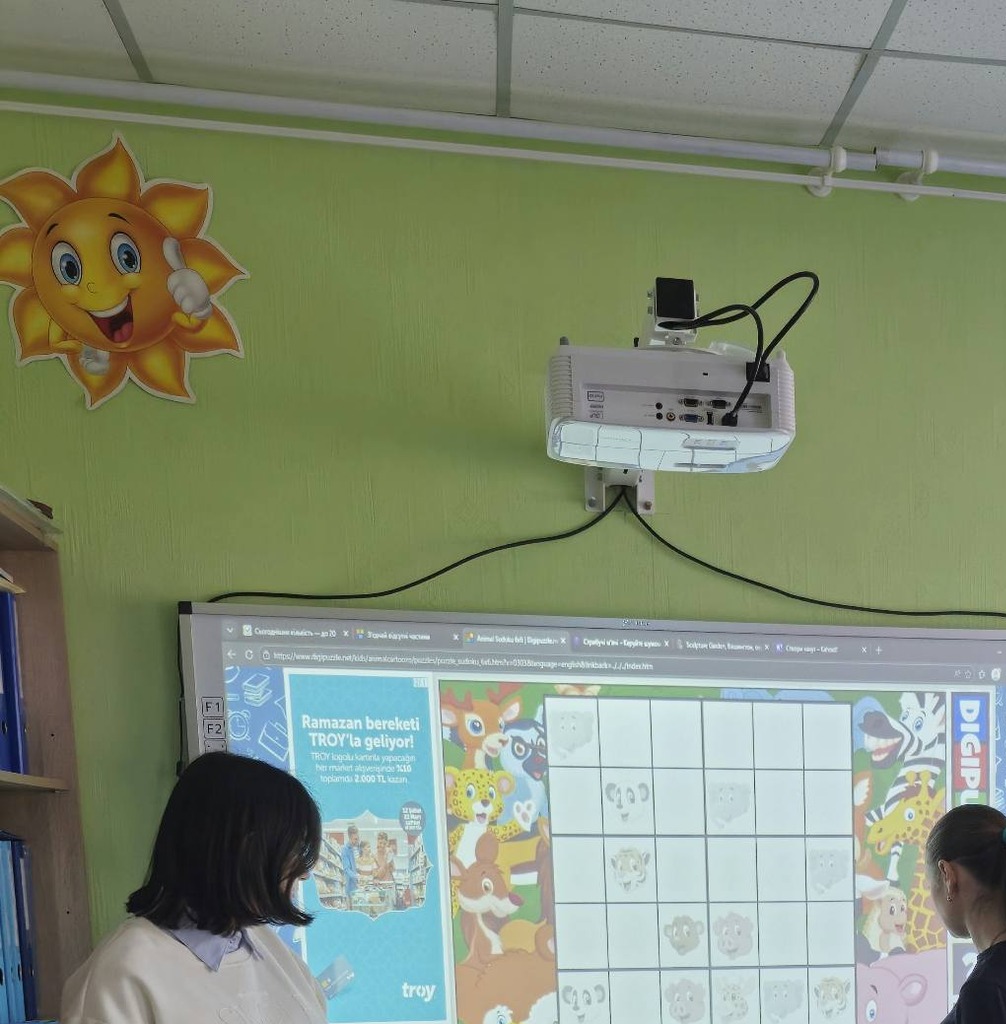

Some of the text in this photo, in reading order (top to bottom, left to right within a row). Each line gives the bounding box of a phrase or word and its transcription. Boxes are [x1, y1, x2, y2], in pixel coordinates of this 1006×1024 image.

[205, 701, 220, 713] F1
[207, 723, 222, 735] F2
[302, 714, 420, 732] Ramazan bereketi
[309, 732, 415, 751] TROY'la geliyor!
[402, 982, 437, 1002] troy
